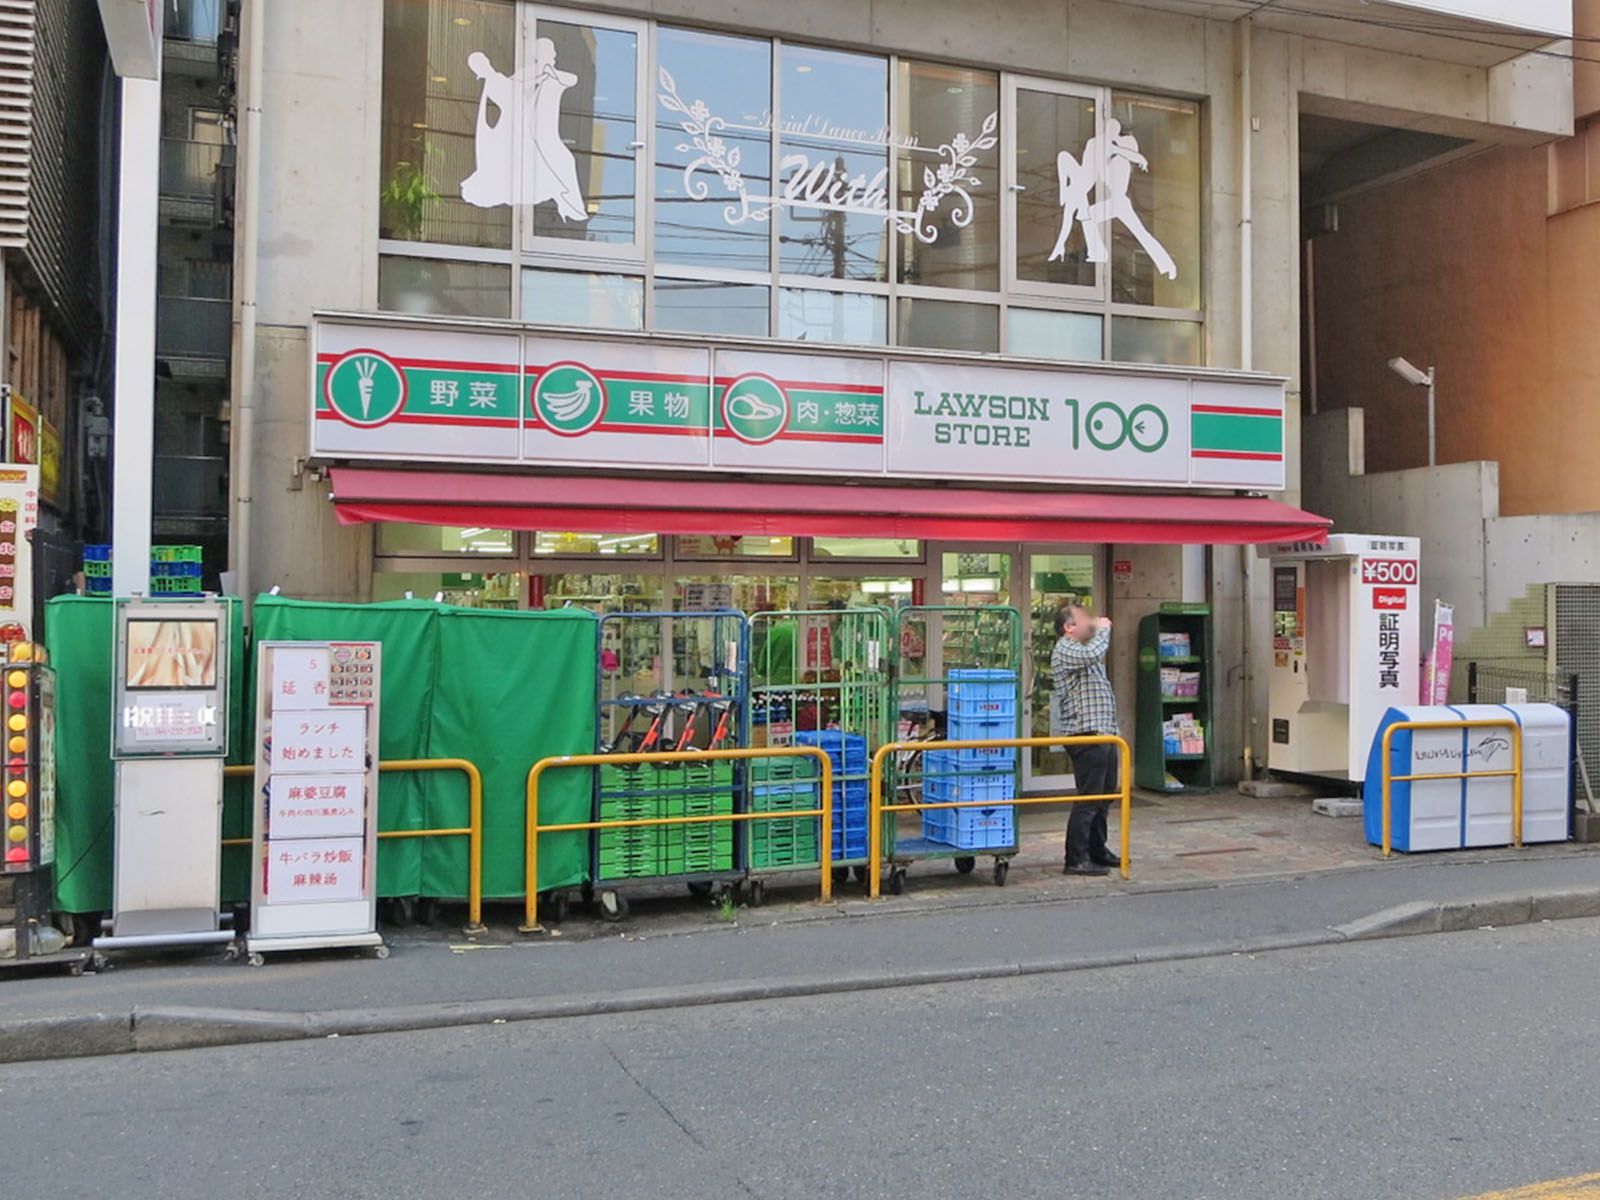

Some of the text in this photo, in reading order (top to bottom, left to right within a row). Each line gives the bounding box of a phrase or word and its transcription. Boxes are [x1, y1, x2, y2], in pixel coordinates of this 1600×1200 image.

[779, 153, 888, 210] With
[430, 380, 497, 409] 野菜
[628, 391, 690, 418] 果物
[914, 391, 1169, 453] LAWSON 100
[935, 423, 1030, 448] STORE
[1364, 561, 1416, 582] ¥500
[1379, 613, 1400, 689] 証明写真
[299, 722, 340, 735] ランチ
[282, 746, 354, 760] 始めました
[288, 785, 347, 800] 麻婆豆腐
[280, 849, 353, 864] 牛バラ炒飯
